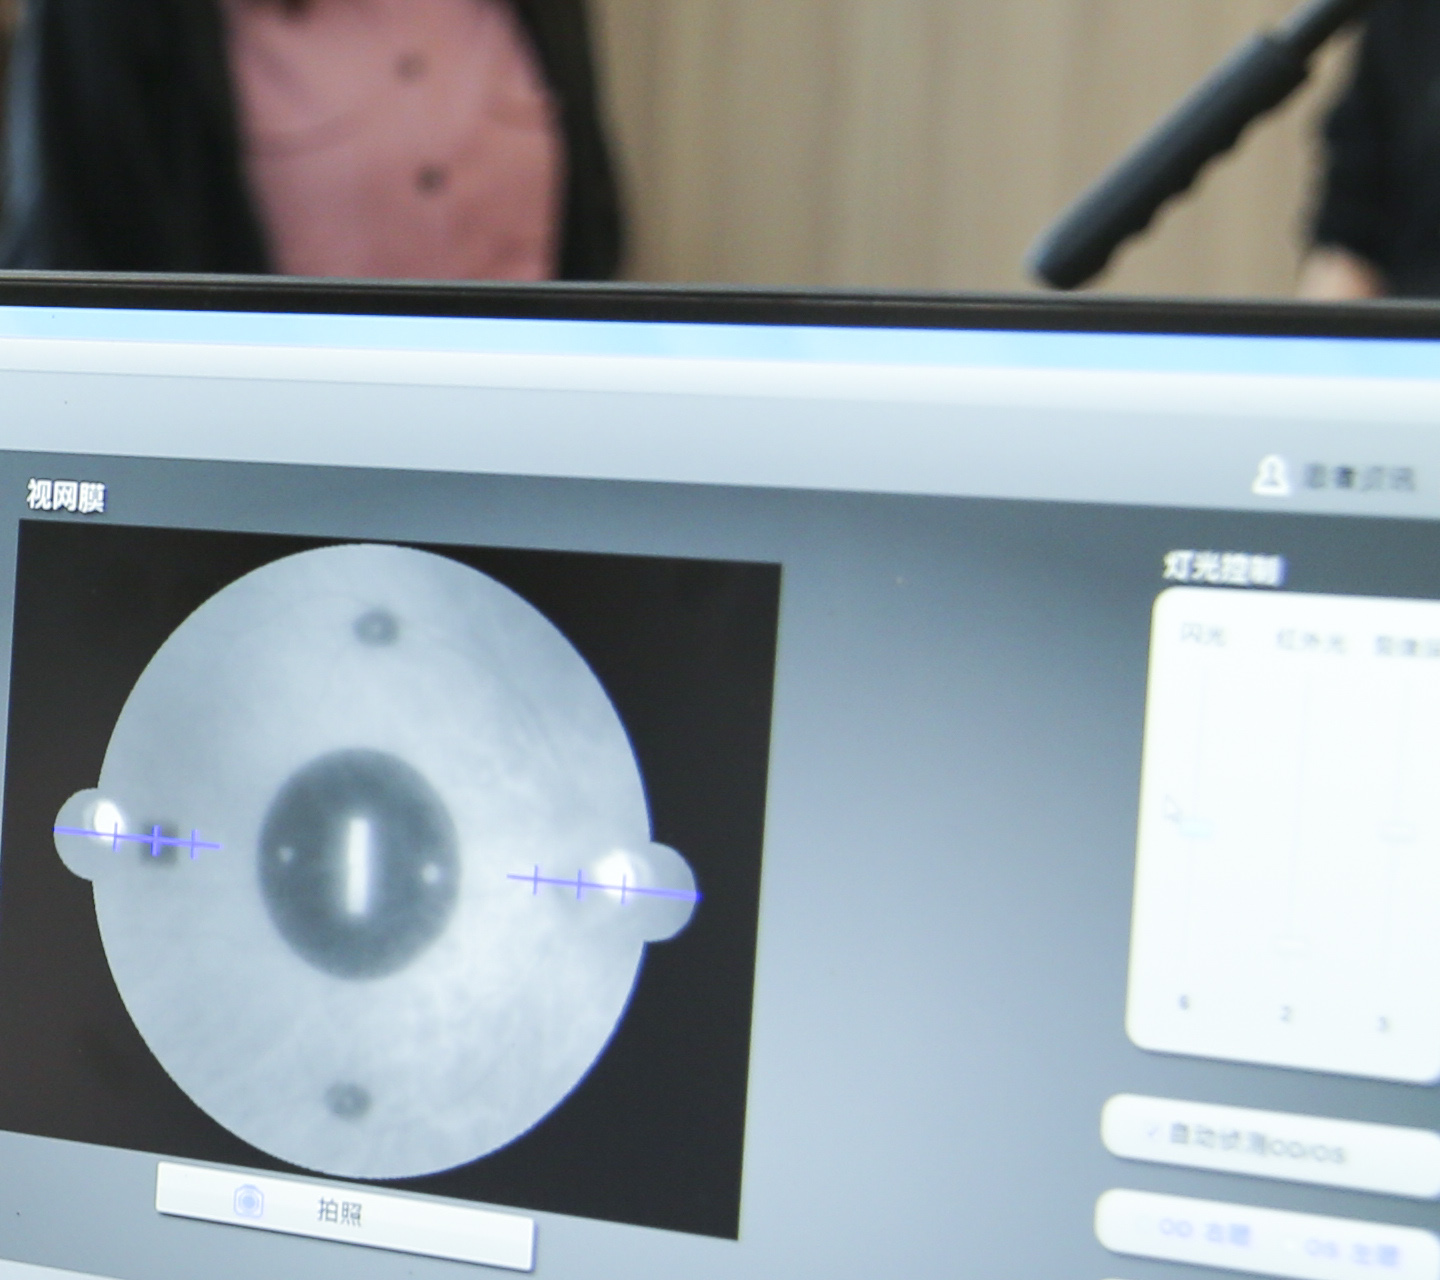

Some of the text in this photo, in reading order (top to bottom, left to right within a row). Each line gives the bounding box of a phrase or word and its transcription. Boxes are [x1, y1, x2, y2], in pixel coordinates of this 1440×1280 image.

[26, 477, 106, 514] 视网膜
[317, 1196, 362, 1227] 拍照
